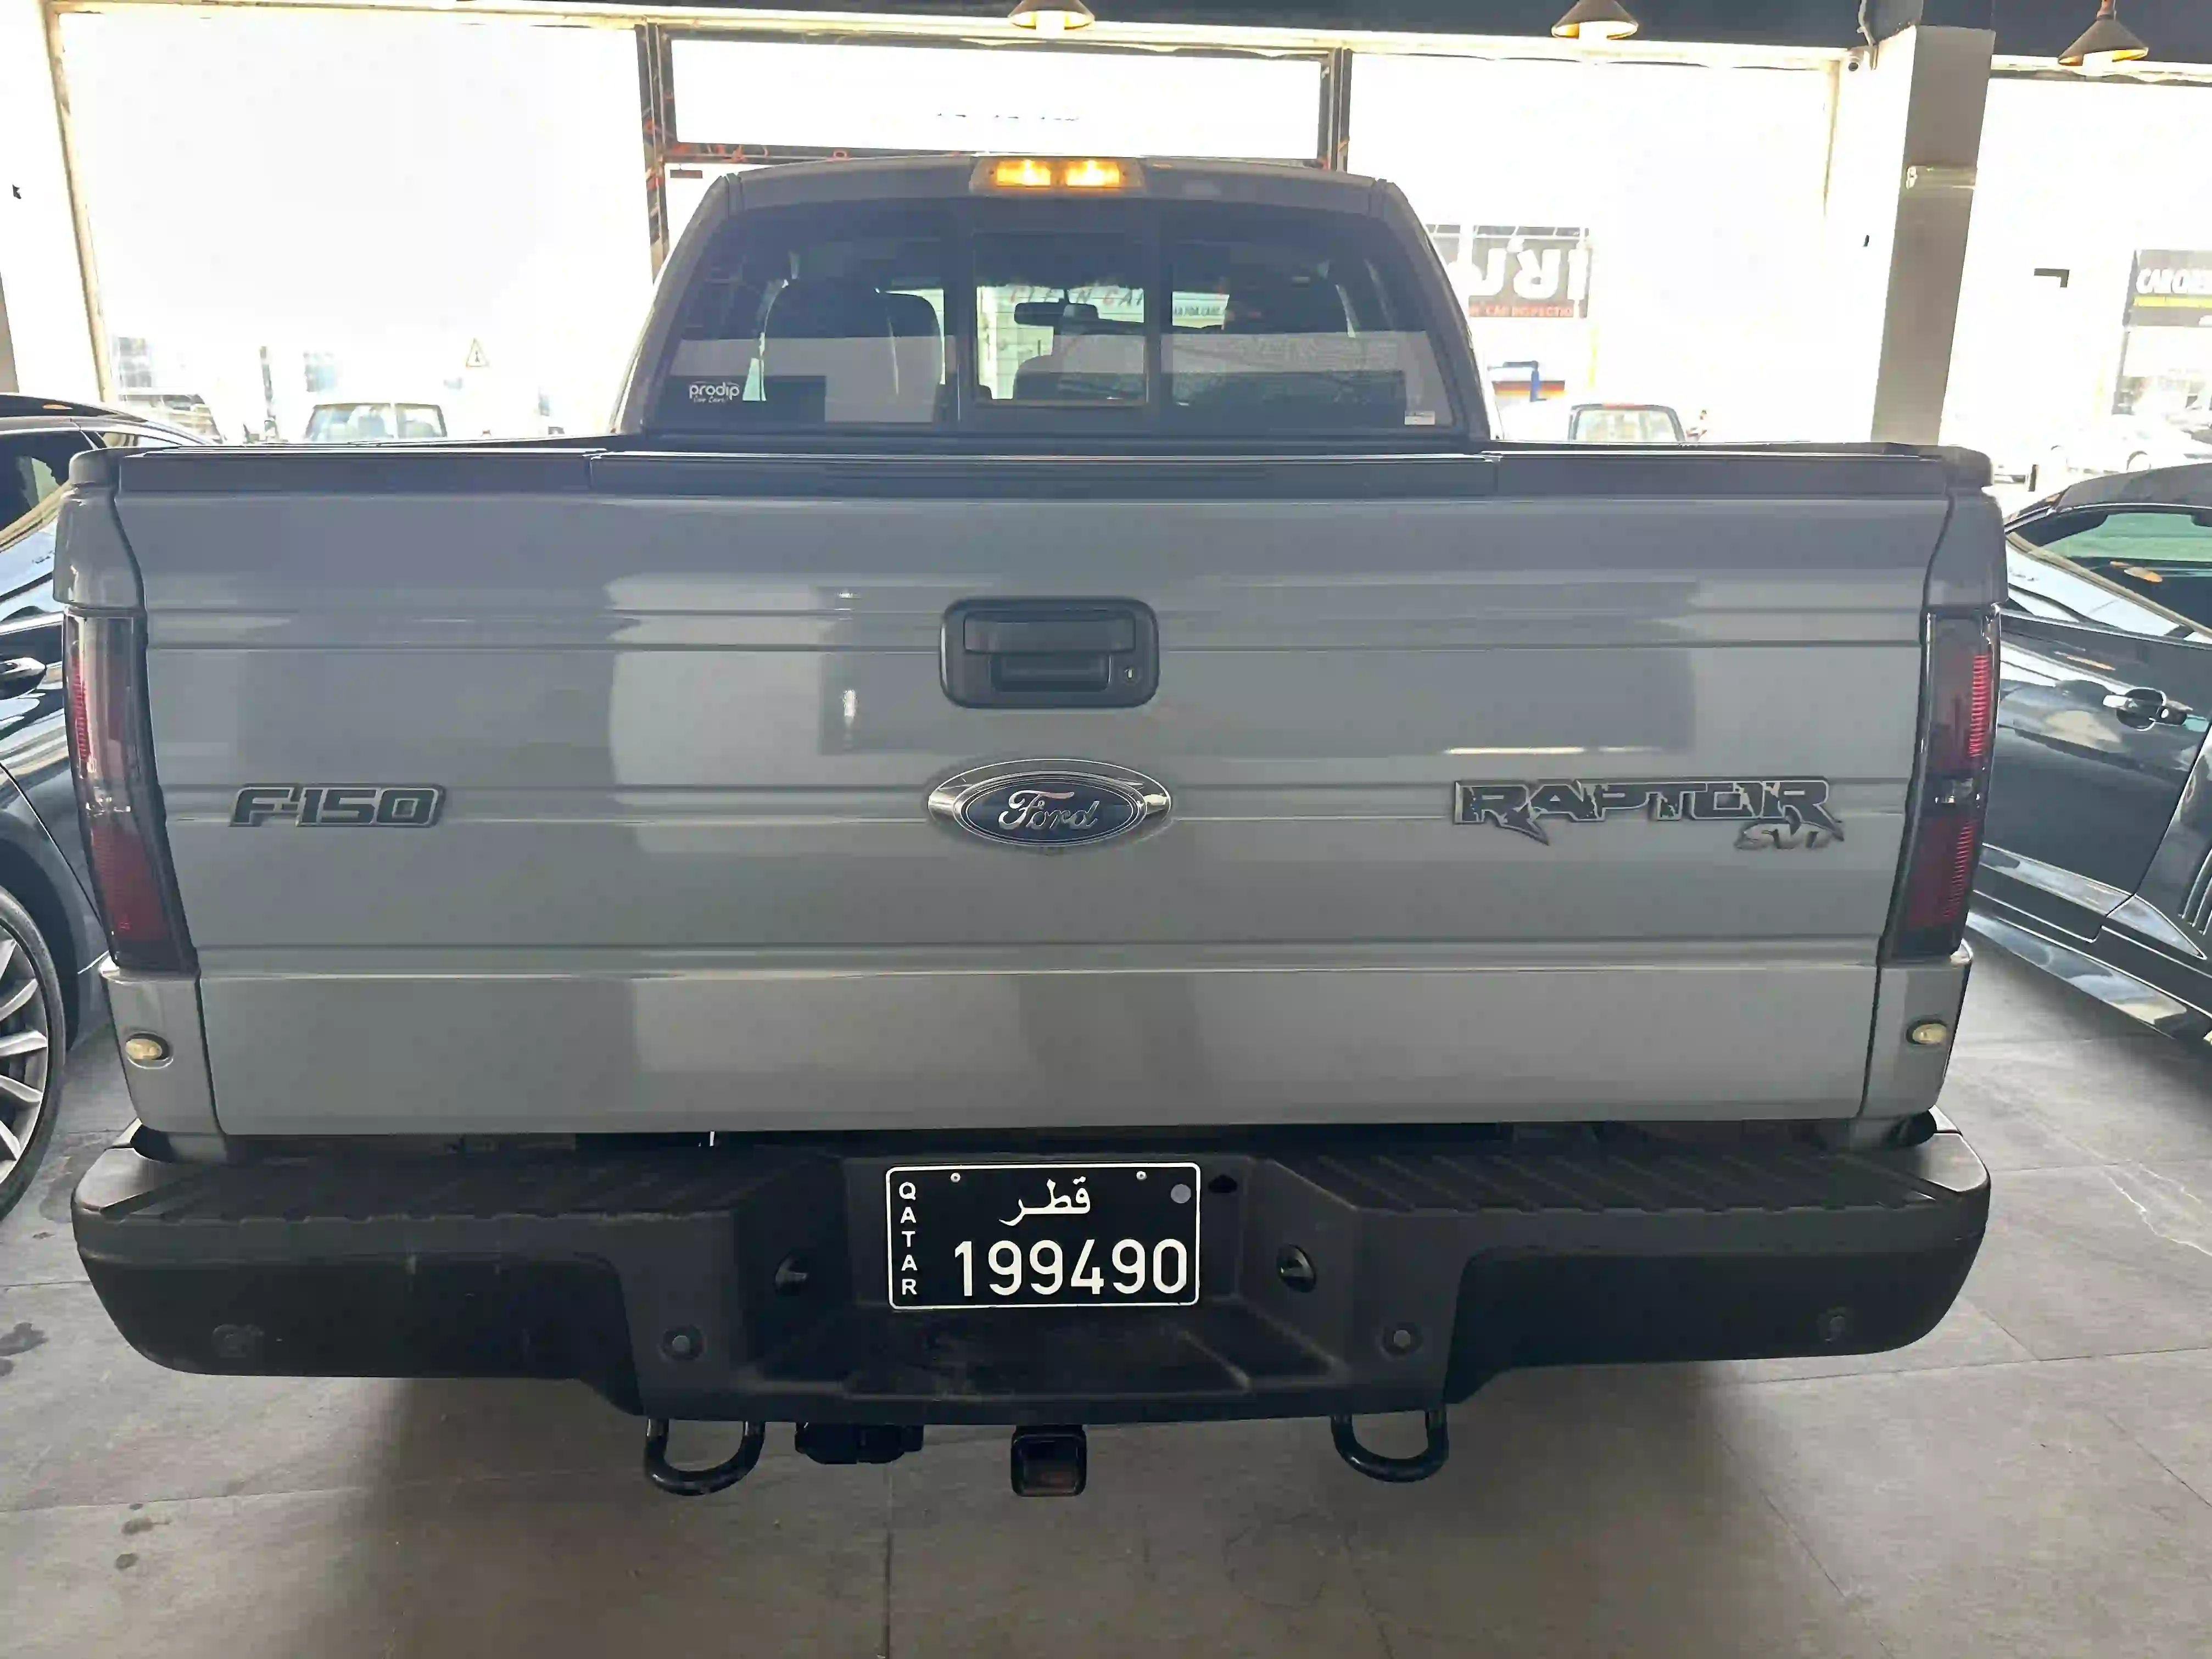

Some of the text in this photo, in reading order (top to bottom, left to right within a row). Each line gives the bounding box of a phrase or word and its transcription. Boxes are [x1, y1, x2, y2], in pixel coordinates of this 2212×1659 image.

[689, 382, 740, 401] prodip
[998, 790, 1100, 830] Ford
[1453, 778, 1844, 846] RAPTOR
[998, 1176, 1091, 1226] قطر
[898, 1181, 918, 1295] QATAR
[954, 1238, 1188, 1297] 199490
